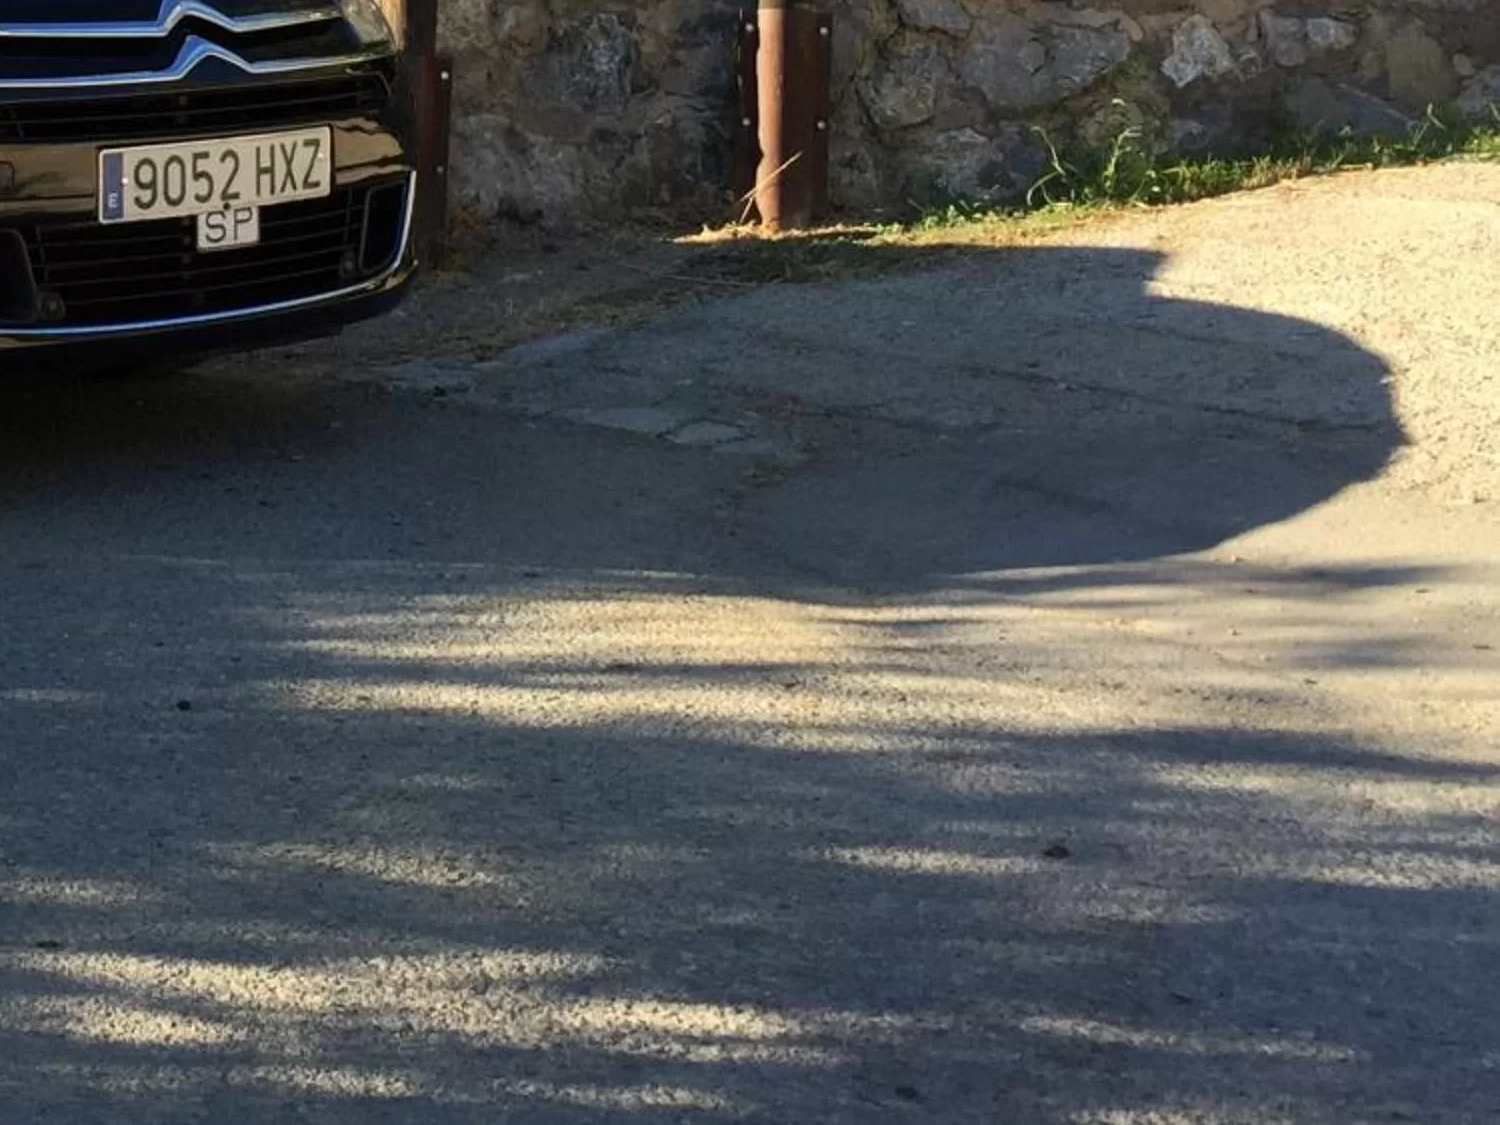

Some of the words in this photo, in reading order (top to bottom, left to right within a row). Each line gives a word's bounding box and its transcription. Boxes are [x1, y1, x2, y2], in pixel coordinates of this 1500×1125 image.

[133, 149, 241, 210] 9052
[255, 138, 322, 197] HXZ
[107, 191, 119, 208] E
[205, 206, 253, 244] SP
